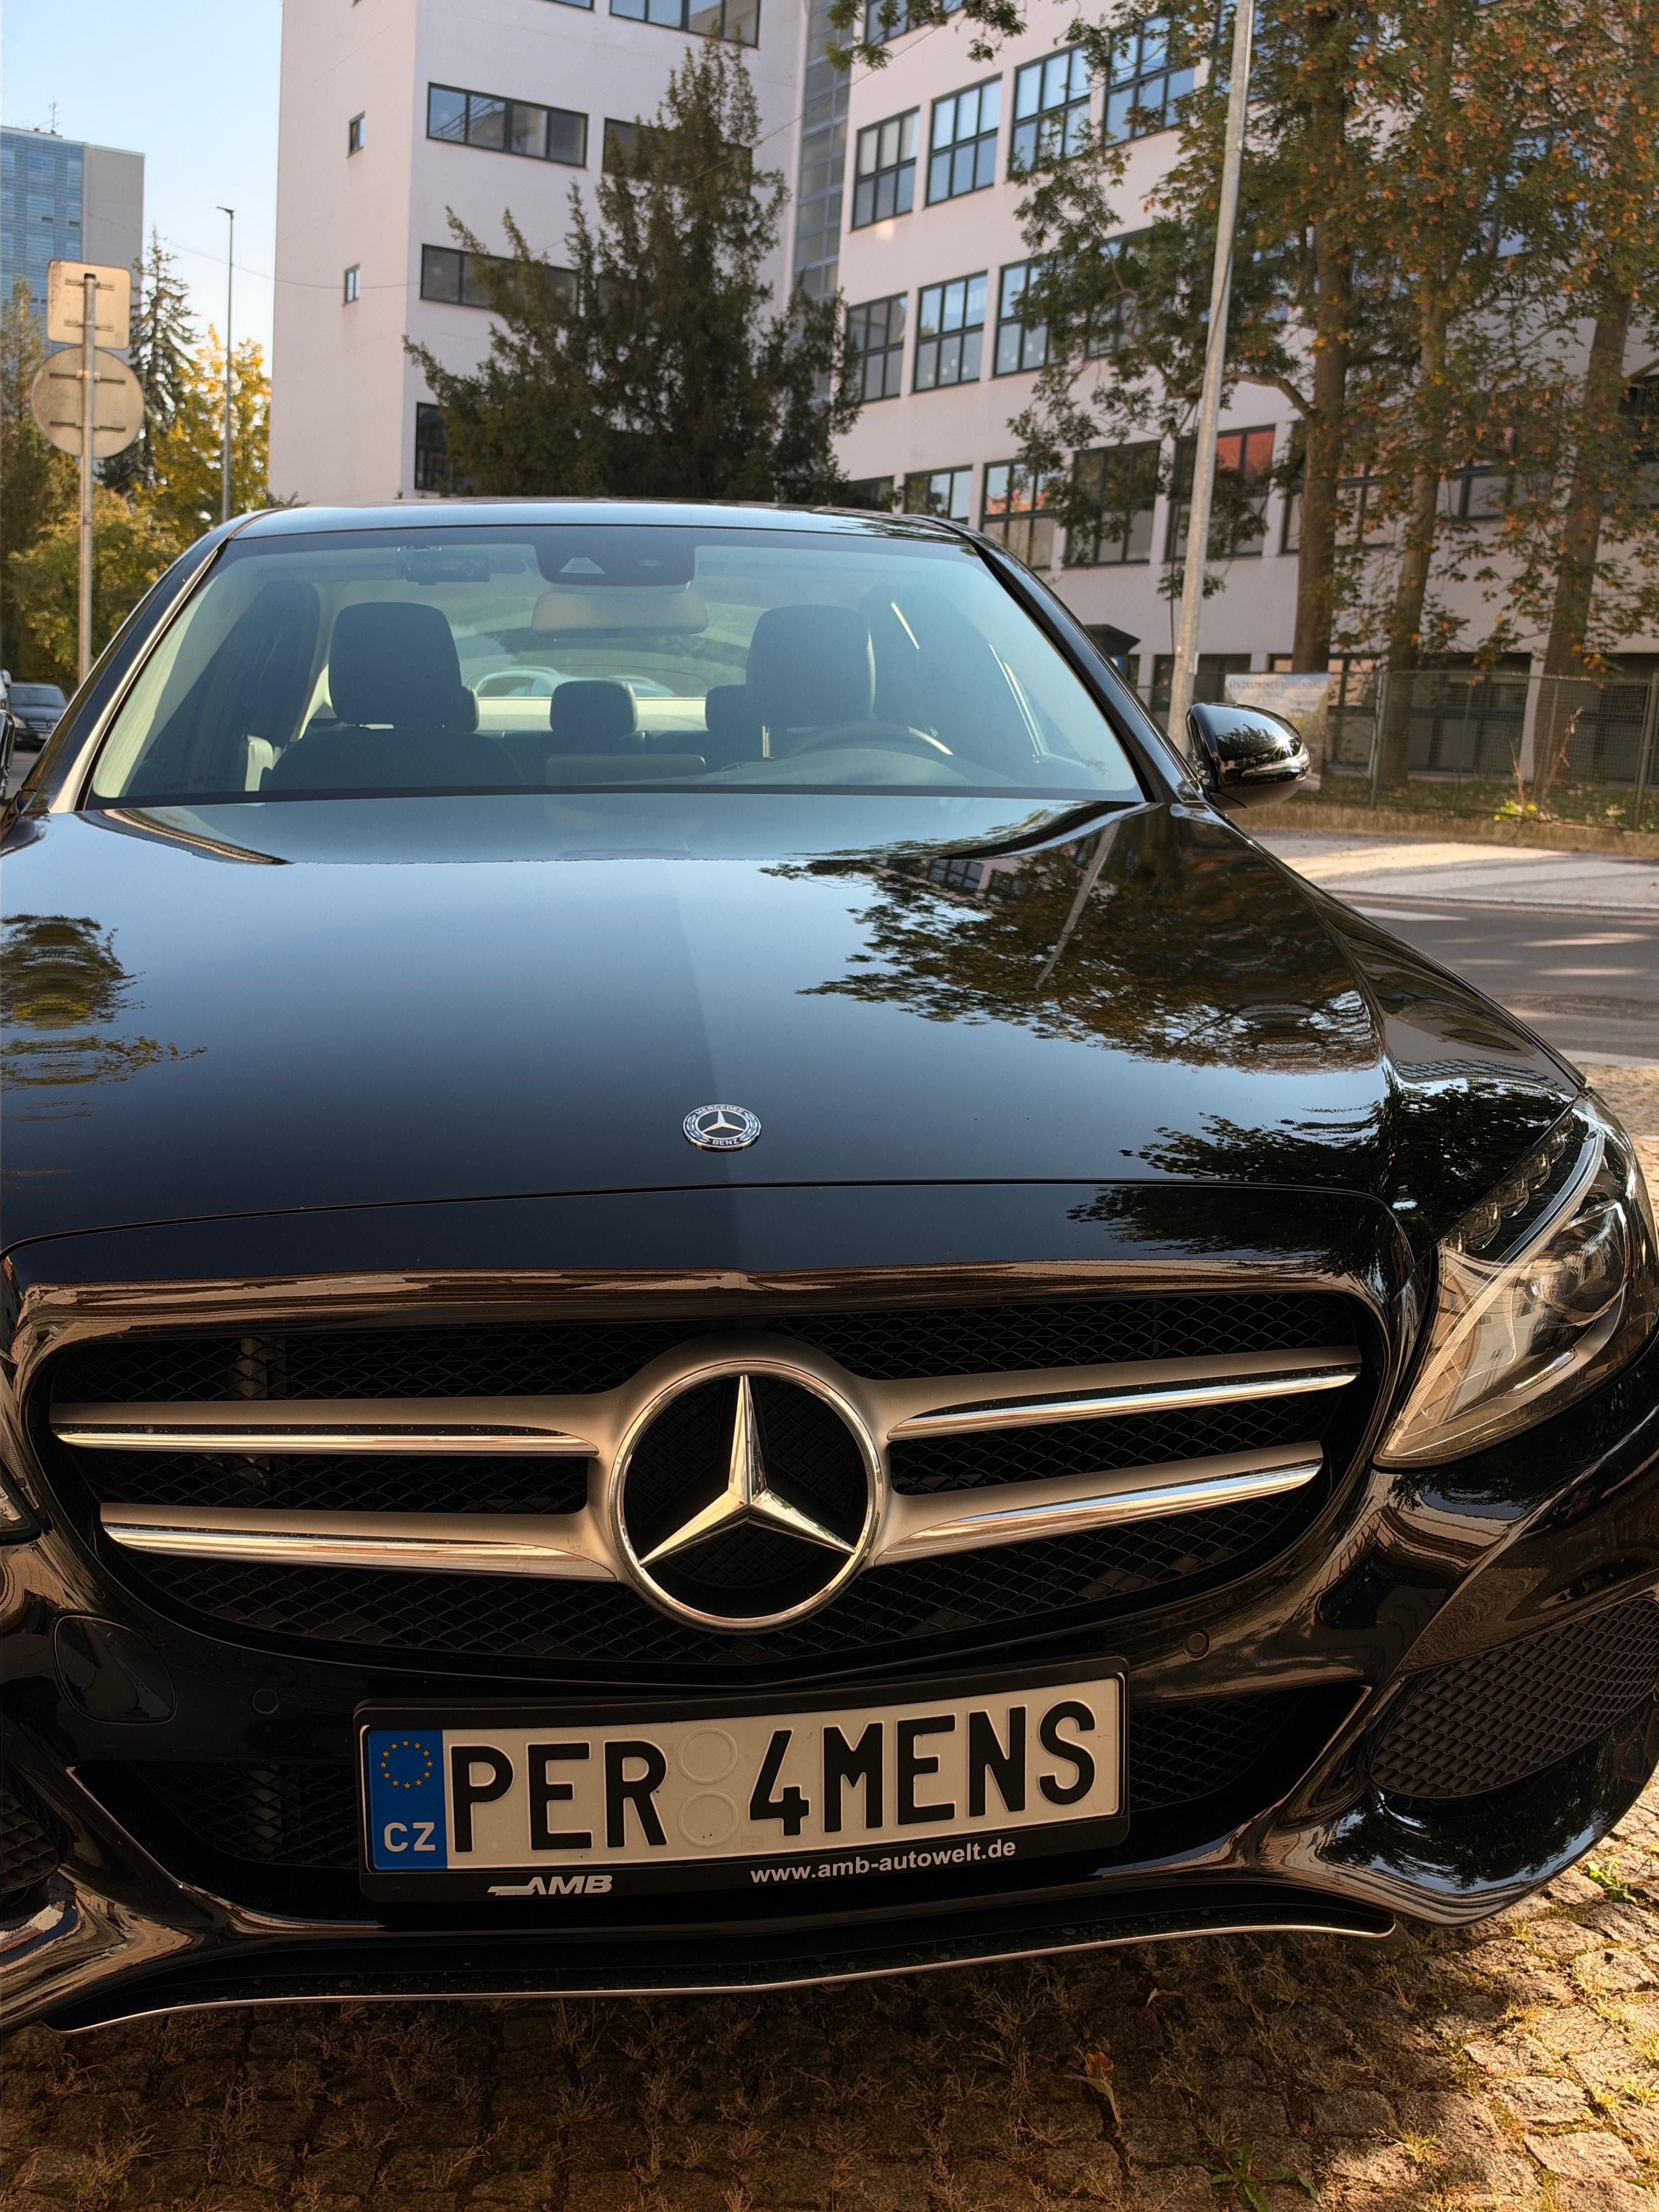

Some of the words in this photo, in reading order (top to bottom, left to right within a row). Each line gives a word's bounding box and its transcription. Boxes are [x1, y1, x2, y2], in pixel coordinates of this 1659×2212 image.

[695, 1105, 744, 1115] MERCEDES
[450, 1740, 667, 1852] PER
[749, 1700, 1096, 1836] 4MENS
[383, 1822, 436, 1852] CZ
[750, 1839, 1016, 1883] www.amb-autowelt.de
[487, 1874, 613, 1896] AMB
